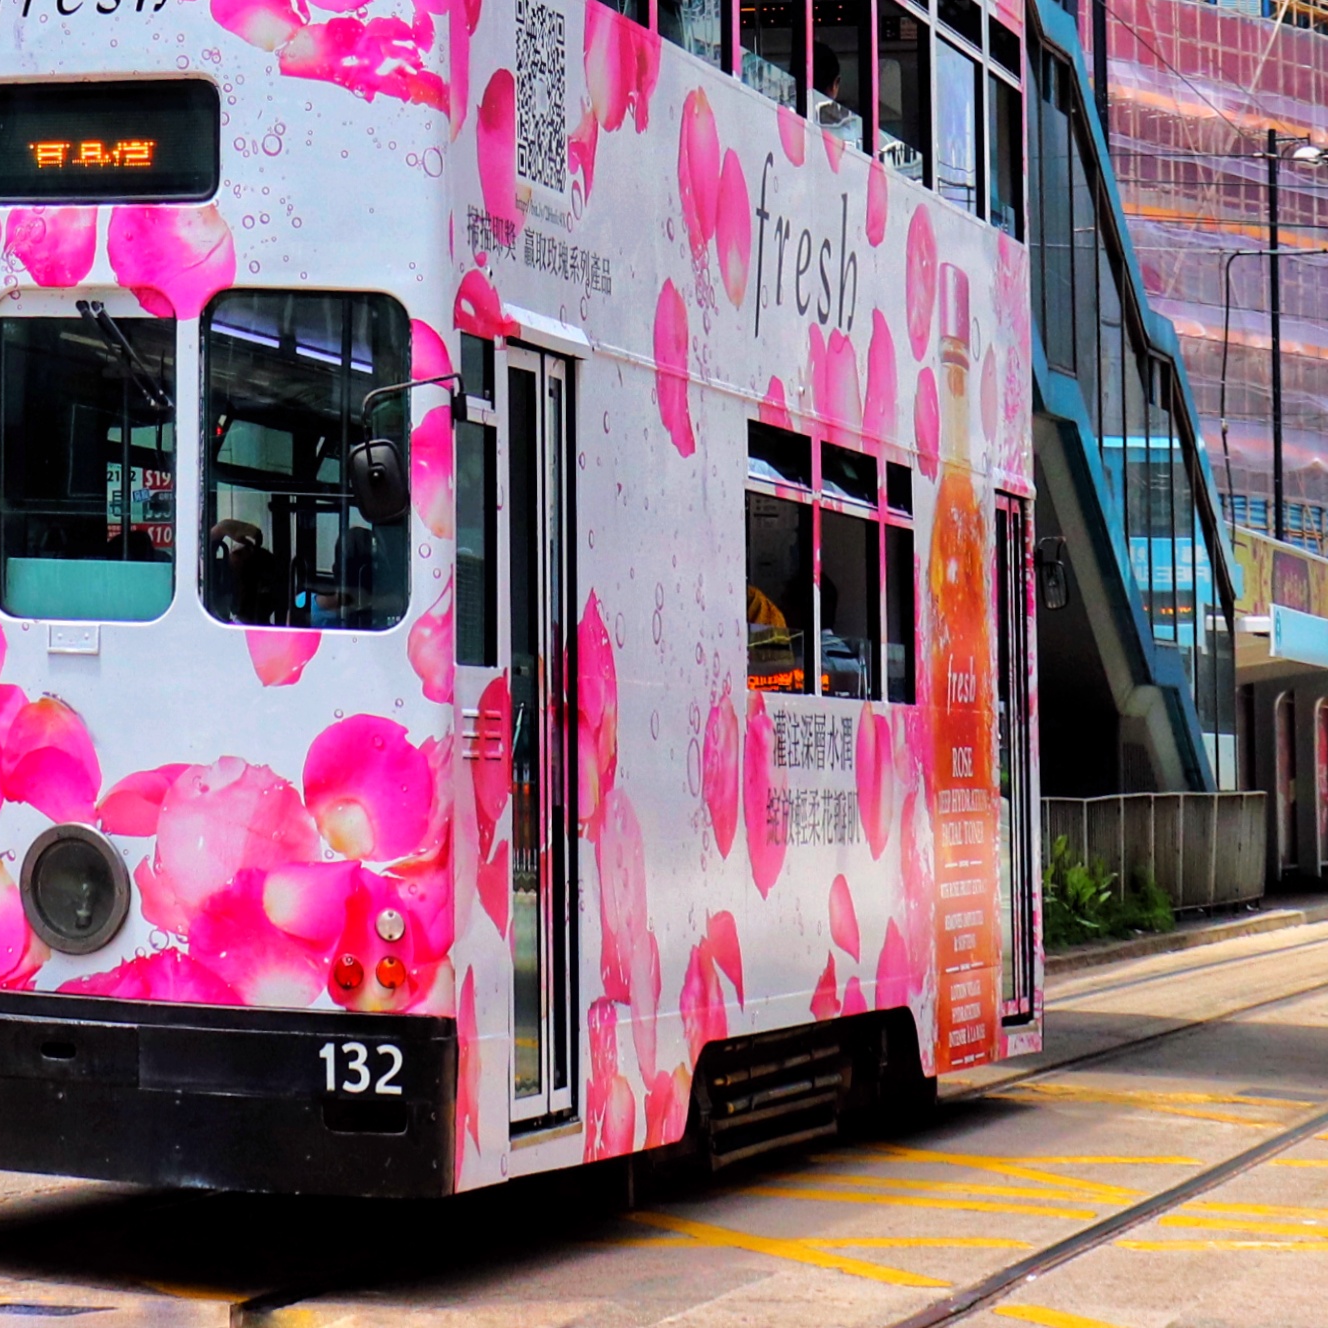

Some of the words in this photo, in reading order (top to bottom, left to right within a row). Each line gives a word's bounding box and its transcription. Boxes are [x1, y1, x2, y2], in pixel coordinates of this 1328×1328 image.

[755, 151, 859, 338] fresh
[947, 653, 977, 716] fresh
[952, 747, 974, 778] ROSE
[318, 1042, 403, 1095] 132
